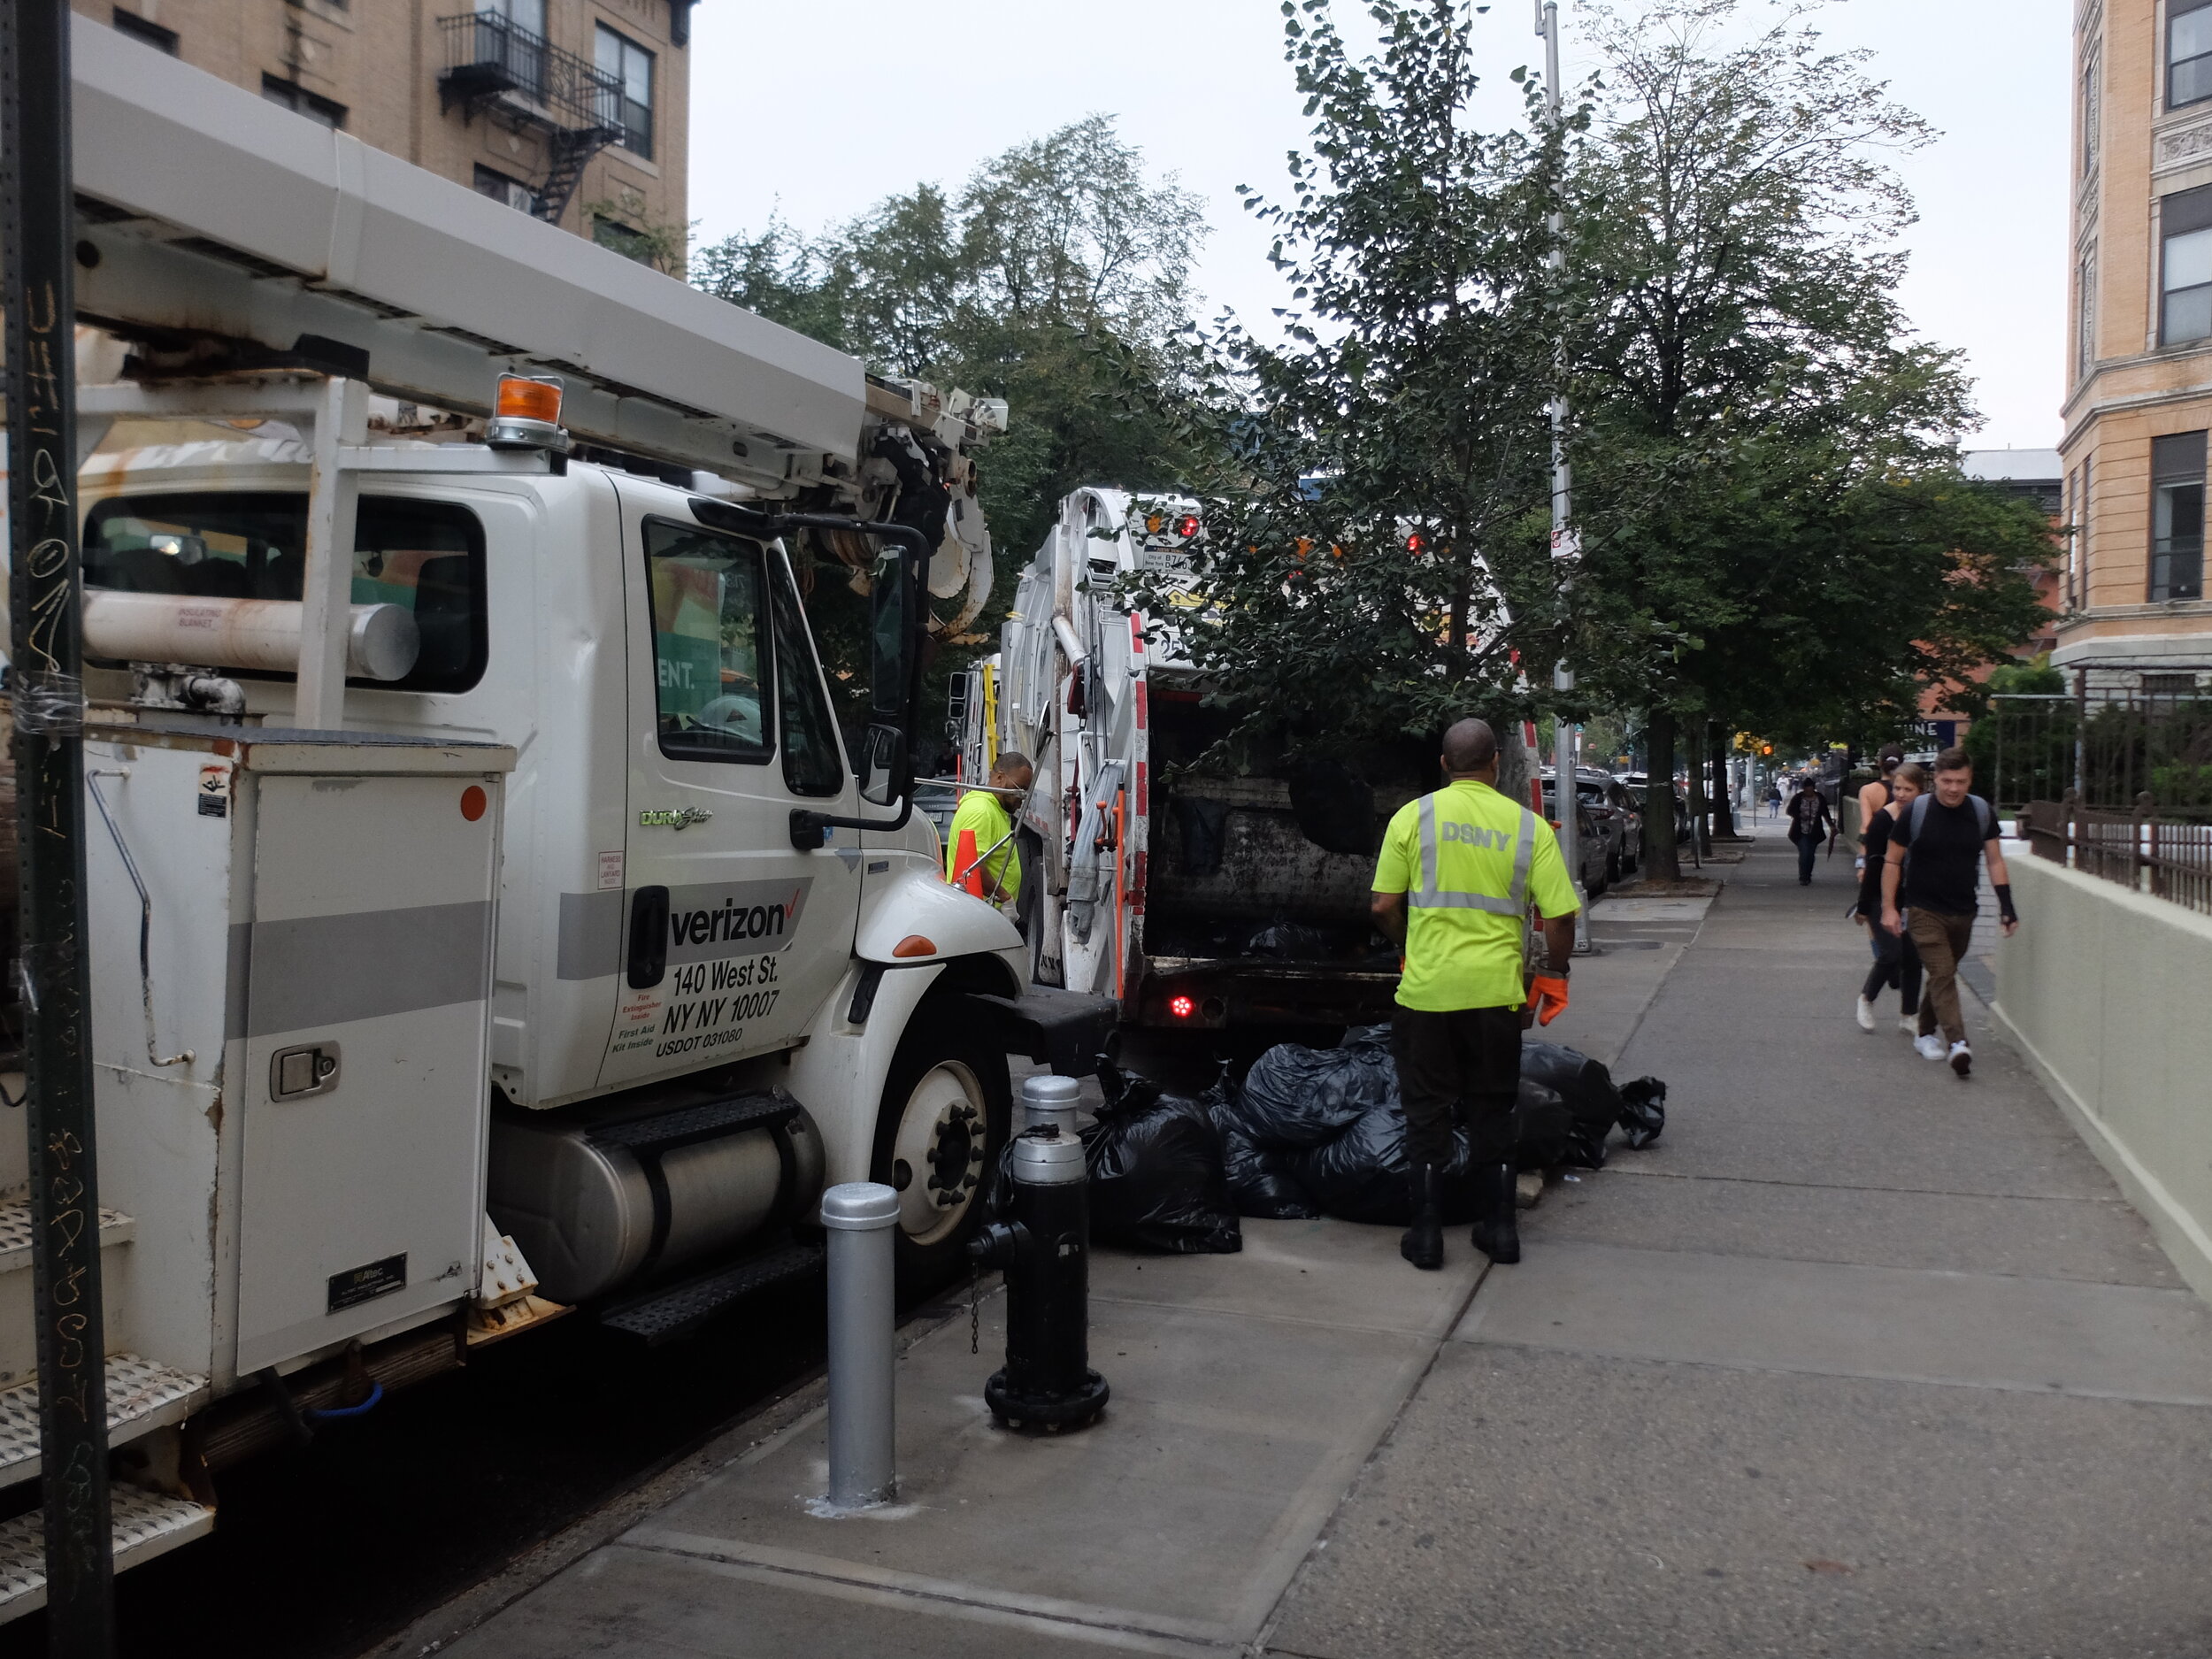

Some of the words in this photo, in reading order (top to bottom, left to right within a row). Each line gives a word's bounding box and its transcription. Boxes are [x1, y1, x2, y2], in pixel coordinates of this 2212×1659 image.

[179, 618, 213, 628] BLANKET
[1442, 821, 1511, 852] DSNY
[672, 898, 784, 946] verizon
[674, 964, 706, 996] 140
[711, 960, 755, 991] West
[757, 956, 779, 984] St.
[662, 1002, 696, 1034] NY
[695, 997, 728, 1028] NY
[731, 990, 780, 1022] 10007
[612, 1043, 626, 1053] Kit
[627, 1039, 654, 1050] Inside
[618, 1028, 638, 1039] First
[641, 1024, 656, 1035] Aid
[656, 1035, 702, 1057] USDOT
[703, 1027, 743, 1048] 031080
